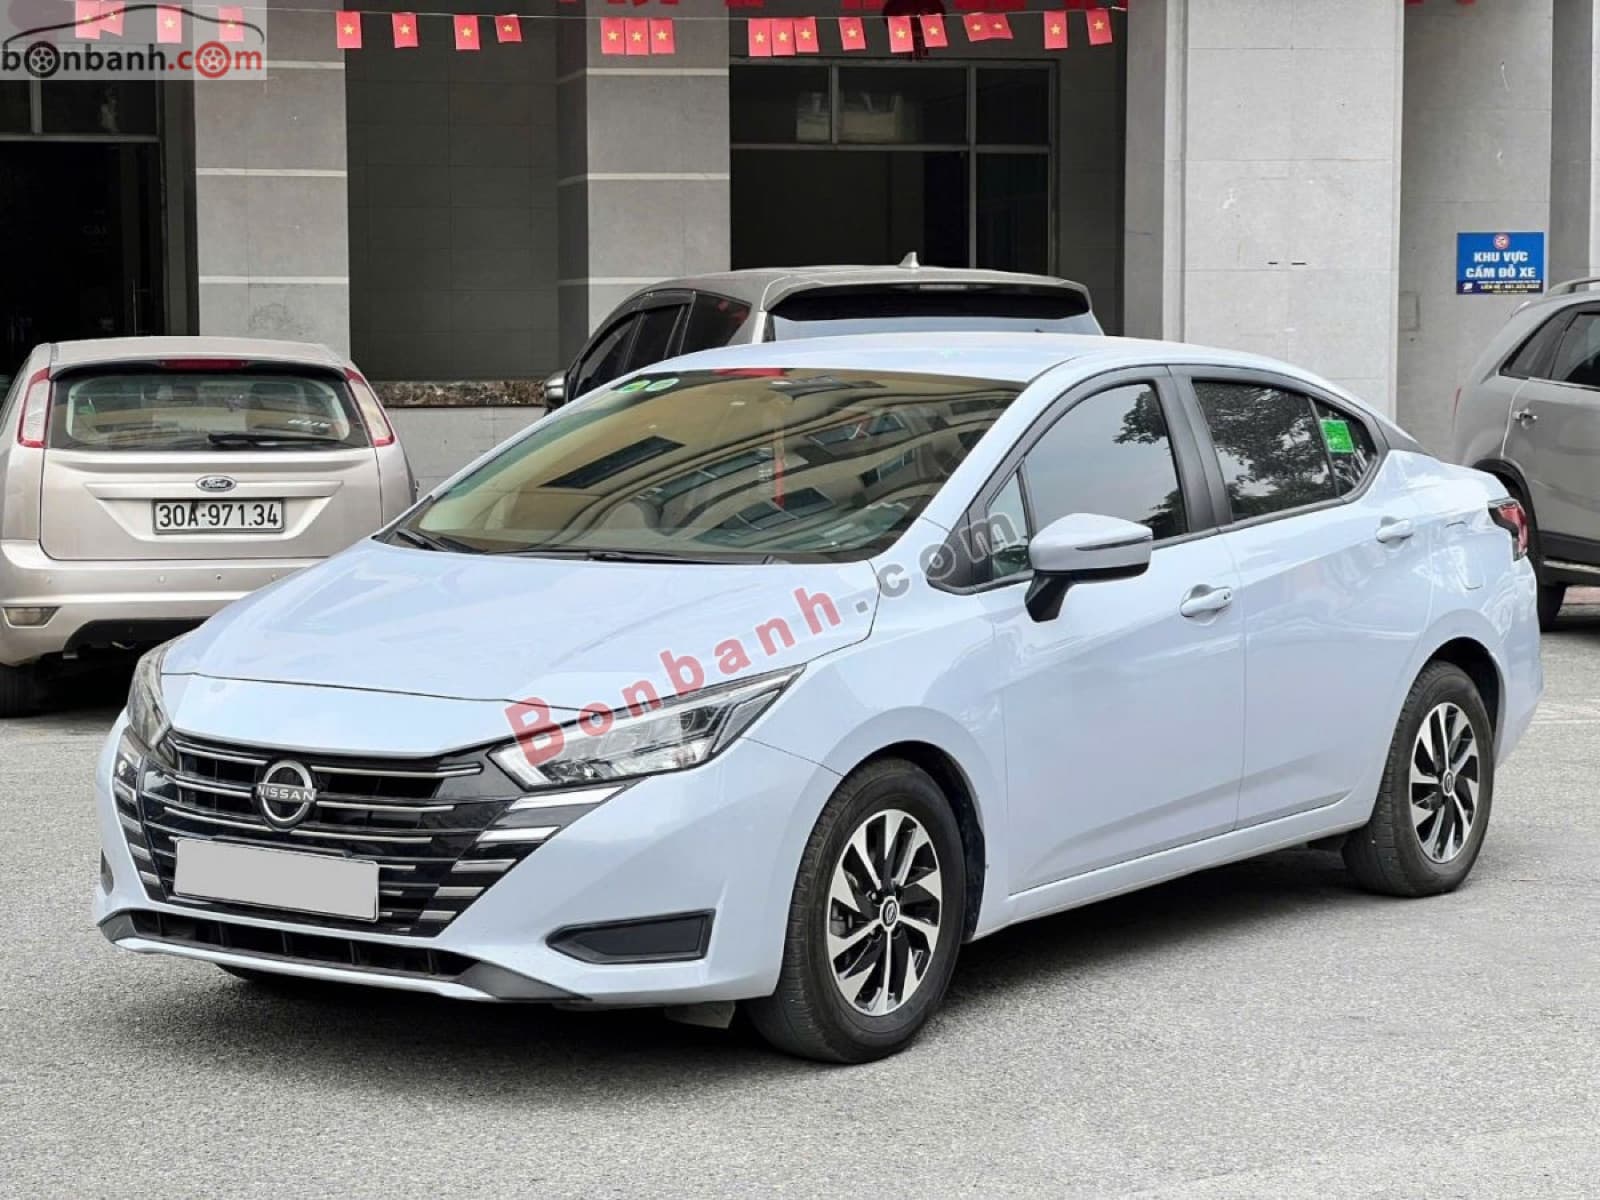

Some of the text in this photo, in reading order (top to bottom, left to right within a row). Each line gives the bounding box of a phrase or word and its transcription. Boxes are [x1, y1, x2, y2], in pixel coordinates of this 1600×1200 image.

[1473, 250, 1528, 264] KHU VỰC
[1466, 264, 1536, 278] CẤM ĐỖ XE
[159, 504, 279, 528] 30A-971.34
[257, 783, 316, 801] NISSAN
